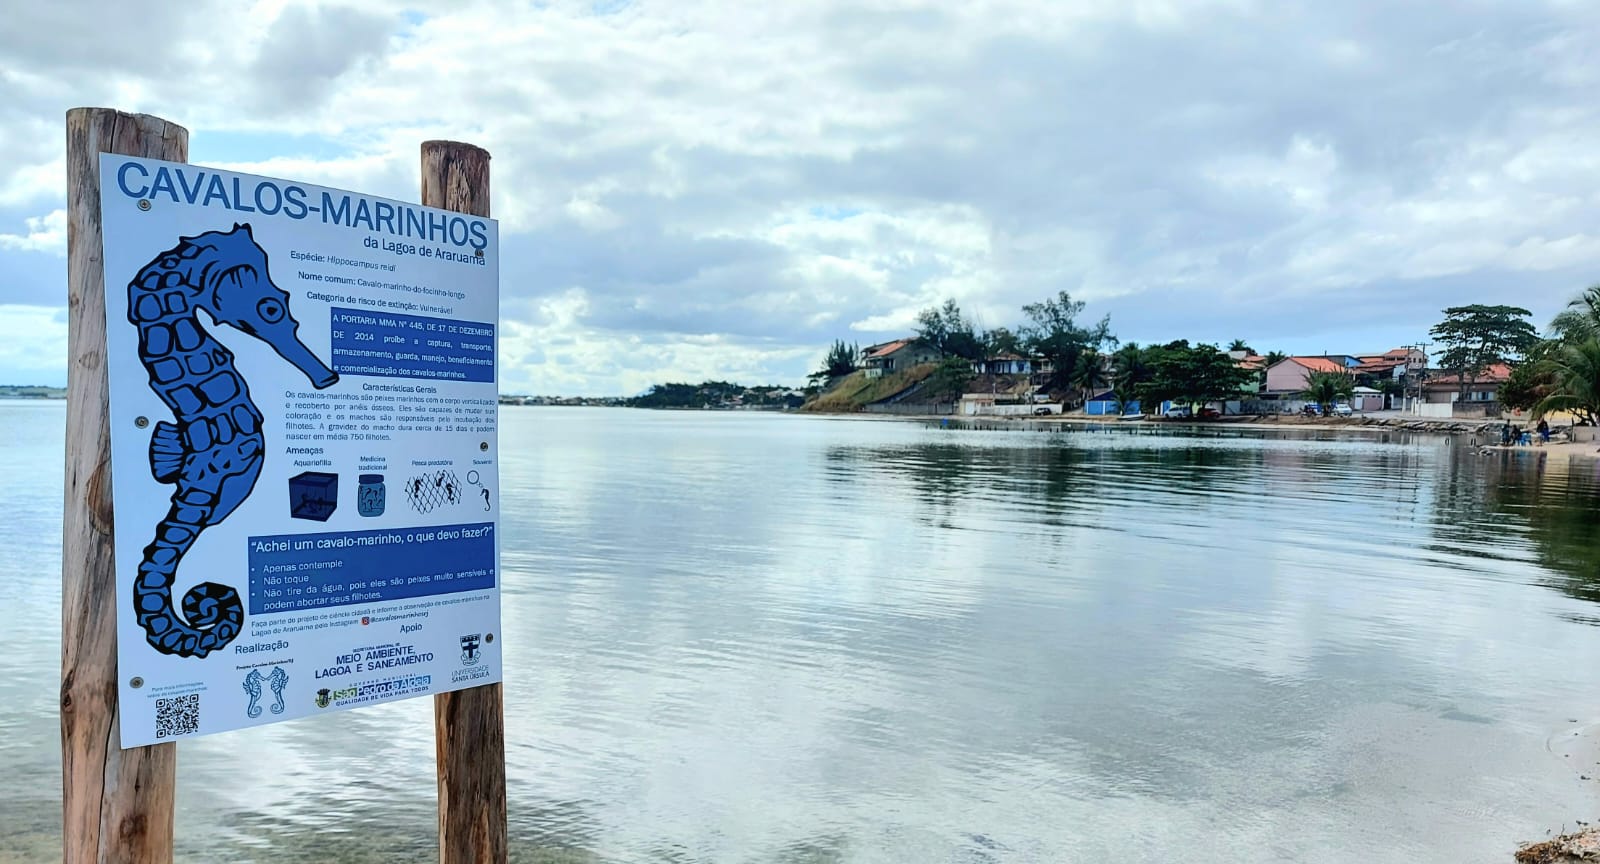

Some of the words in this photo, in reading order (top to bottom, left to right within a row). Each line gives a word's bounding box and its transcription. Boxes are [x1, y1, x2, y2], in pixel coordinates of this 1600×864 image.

[117, 161, 488, 250] CAVALOS-MARINHOS
[363, 235, 379, 248] da
[382, 239, 416, 256] Lagoa
[419, 245, 433, 257] de
[435, 248, 486, 265] Araruama
[290, 250, 325, 263] Espécie:
[327, 255, 379, 270] Hippocampus
[380, 262, 396, 272] reidi
[298, 271, 322, 281] Nome
[325, 275, 356, 285] comum:
[357, 278, 466, 300] Cavalo-marinho-do-focinho-longo
[306, 291, 344, 304] Categoria
[346, 295, 356, 304] de
[358, 296, 376, 306] risco
[377, 298, 387, 307] de
[388, 300, 418, 311] extinção:
[420, 303, 453, 314] Vulnerável
[341, 315, 377, 325] PORTARIA
[379, 318, 397, 328] MMA
[409, 322, 424, 331] 445,
[427, 323, 435, 331] DE
[438, 324, 445, 332] 17
[448, 325, 456, 333] DE
[459, 326, 493, 337] DEZEMBRO
[333, 331, 344, 339] DE
[354, 332, 374, 341] 2014
[383, 335, 405, 344] proíbe
[427, 339, 453, 349] captura,
[461, 342, 493, 353] transporte,
[333, 348, 394, 360] armazenamento,
[395, 352, 420, 361] guarda,
[421, 354, 446, 364] manejo,
[448, 356, 493, 367] beneficiamento
[340, 364, 397, 375] comercialização
[398, 367, 410, 375] dos
[411, 369, 467, 379] cavalos-marinhos.
[362, 382, 415, 393] Características
[416, 386, 437, 394] Gerais
[285, 390, 295, 399] Os
[297, 391, 359, 401] cavalos-marinhos
[361, 393, 373, 401] são
[374, 395, 395, 403] peixes
[396, 395, 424, 403] marinhos
[294, 401, 330, 410] recoberto
[334, 403, 346, 411] por
[398, 404, 412, 412] Eles
[414, 405, 426, 413] são
[285, 411, 321, 421] coloração
[349, 413, 376, 421] machos
[379, 414, 392, 422] são
[395, 415, 434, 423] responsáveis
[285, 422, 316, 430] filhotes.
[319, 422, 325, 430] A
[328, 423, 357, 432] gravidez
[360, 423, 370, 431] do
[372, 423, 395, 432] macho
[476, 425, 495, 433] podem
[326, 433, 348, 441] média
[350, 433, 364, 441] 750
[365, 433, 392, 441] filhotes.
[285, 446, 324, 456] Ameaças
[293, 458, 332, 468] Aquariofilia
[358, 463, 388, 471] tradicional
[294, 541, 314, 551] um
[316, 533, 404, 549] cavalo-marinho,
[406, 534, 413, 542] o
[416, 531, 434, 545] que
[437, 529, 459, 540] devo
[263, 563, 297, 574] Apenas
[298, 559, 343, 572] contemple
[263, 575, 281, 585] Não
[284, 574, 309, 586] toque
[263, 588, 281, 599] Não
[286, 586, 302, 596] tire
[306, 584, 317, 594] da
[322, 583, 345, 595] água,
[349, 580, 366, 592] pois
[370, 579, 386, 588] eles
[390, 577, 404, 587] são
[407, 575, 431, 586] peixes
[434, 571, 453, 582] muito
[456, 569, 487, 580] sensíveis
[489, 568, 494, 576] e
[263, 600, 295, 611] podem
[296, 597, 328, 607] abortar
[330, 595, 350, 603] seus
[351, 592, 382, 601] filhotes.
[251, 620, 267, 629] Faça
[268, 618, 286, 627] parte
[297, 615, 319, 624] projeto
[399, 622, 423, 634] Apoio
[251, 628, 271, 638] Lagoa
[272, 627, 281, 635] de
[282, 624, 313, 634] Araruama
[235, 640, 289, 655] Realização
[336, 652, 361, 665] MEIO
[365, 645, 416, 661] AMBIENTE,
[314, 665, 352, 679] LAGOA
[356, 663, 363, 672] E
[367, 652, 434, 671] SANEAMENTO
[335, 695, 369, 707] QUALIDADE
[380, 691, 394, 699] VIDA
[394, 689, 409, 697] PARA
[410, 685, 429, 694] TODOS
